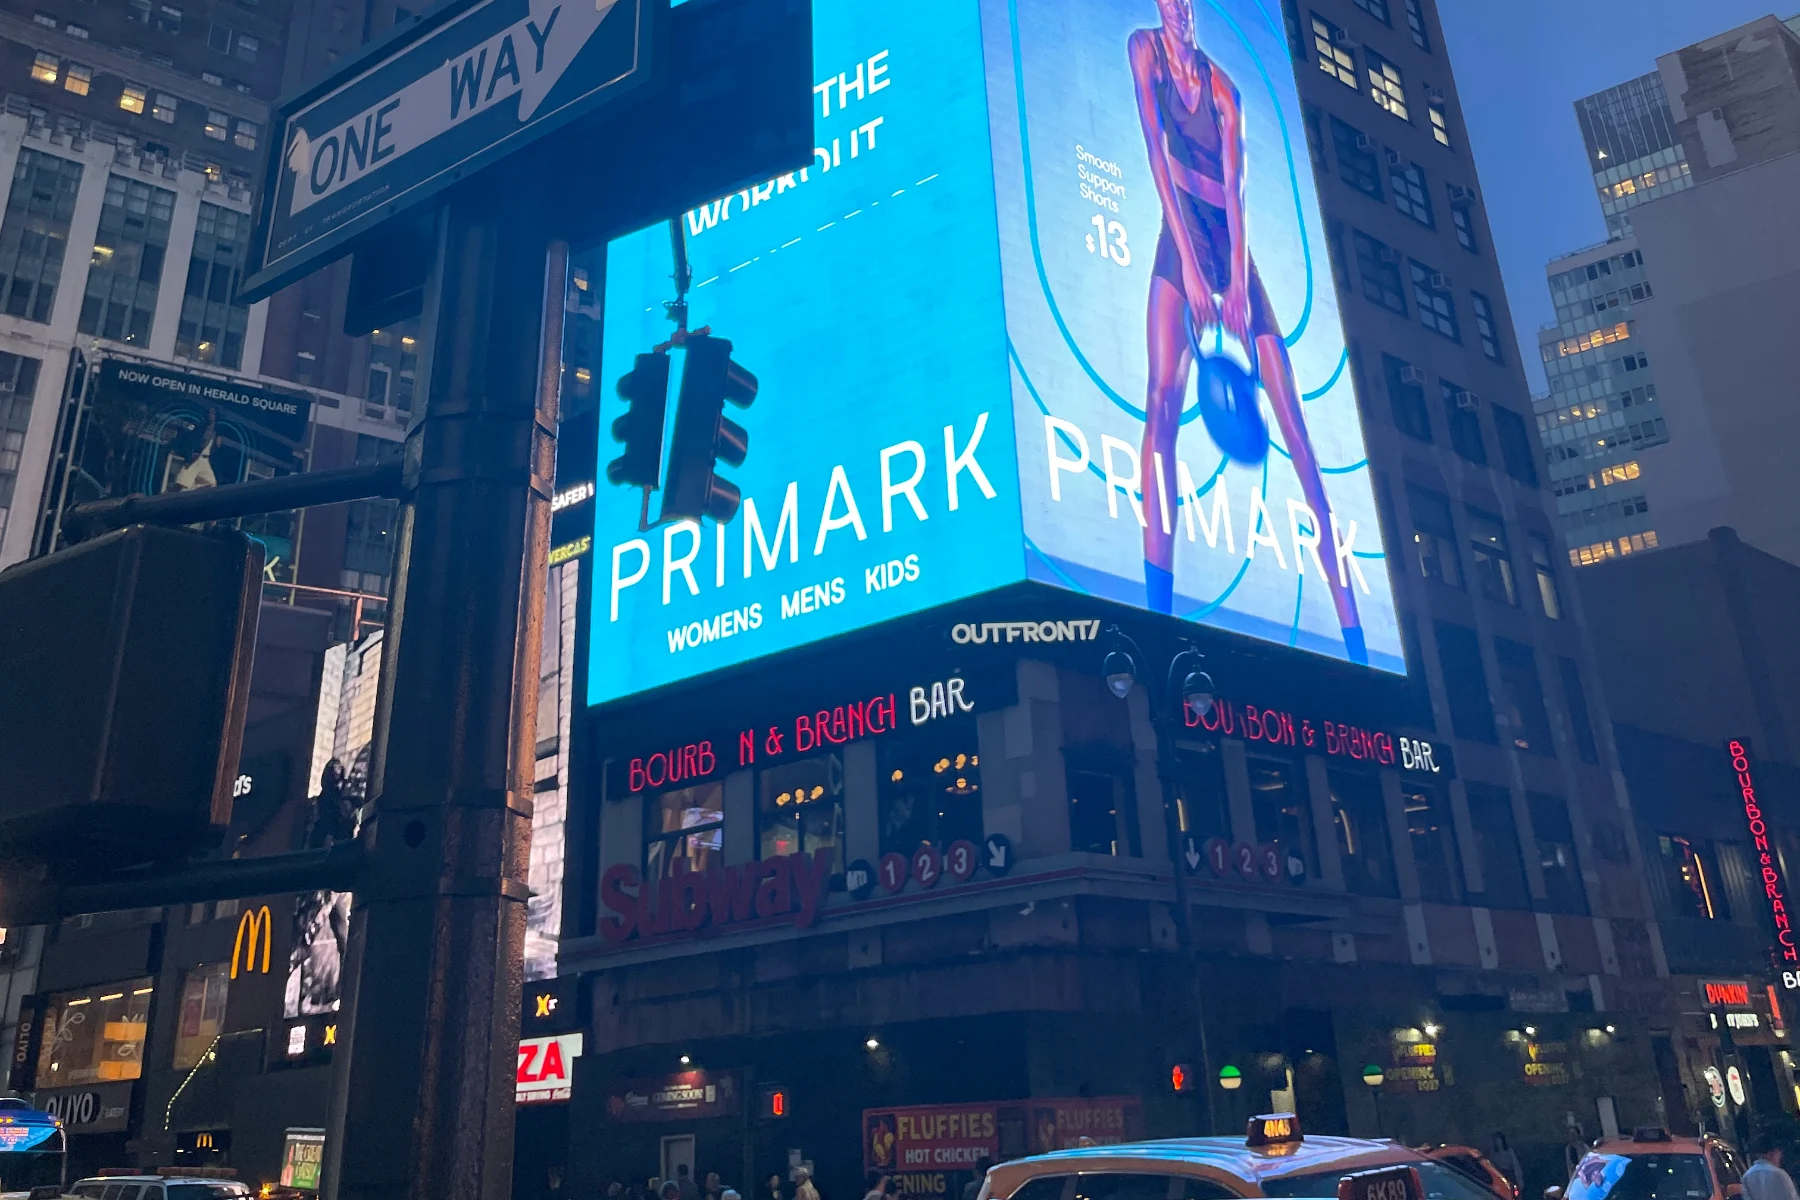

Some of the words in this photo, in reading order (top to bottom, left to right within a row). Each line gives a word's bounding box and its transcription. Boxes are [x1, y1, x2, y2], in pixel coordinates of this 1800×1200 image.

[309, 99, 398, 197] ONE
[447, 4, 563, 122] WAY
[812, 49, 890, 118] THE
[1076, 144, 1122, 179] Smooth
[1077, 163, 1126, 200] Support
[1080, 182, 1119, 213] Shorts
[1085, 213, 1131, 267] $13
[118, 369, 150, 384] NOW
[152, 376, 186, 393] OPEN
[188, 384, 201, 395] IN
[203, 387, 250, 405] HERALD
[252, 397, 298, 415] SQUARE
[610, 411, 998, 623] PRIMARK
[1044, 414, 1371, 596] PRIMARK
[549, 536, 591, 565] VERCAS
[667, 603, 763, 654] WOMENS
[781, 576, 845, 620] MENS
[865, 553, 920, 595] KIDS
[765, 725, 784, 755] &
[796, 693, 896, 752] BRANCH
[908, 676, 975, 727] BAR
[1183, 696, 1296, 747] BOUBON
[1324, 720, 1395, 765] BRANCH
[1399, 736, 1440, 774] BAR
[1729, 740, 1768, 851] BOURBON
[1759, 853, 1771, 865] &
[601, 847, 836, 943] Subway
[919, 855, 934, 879] 2
[954, 848, 968, 873] 3
[1761, 866, 1797, 961] BRANCH
[1782, 971, 1800, 989] B
[517, 1041, 565, 1083] ZA
[897, 1112, 994, 1141] FLUFFIES
[905, 1148, 930, 1163] HOT
[934, 1147, 989, 1163] CHICKEN
